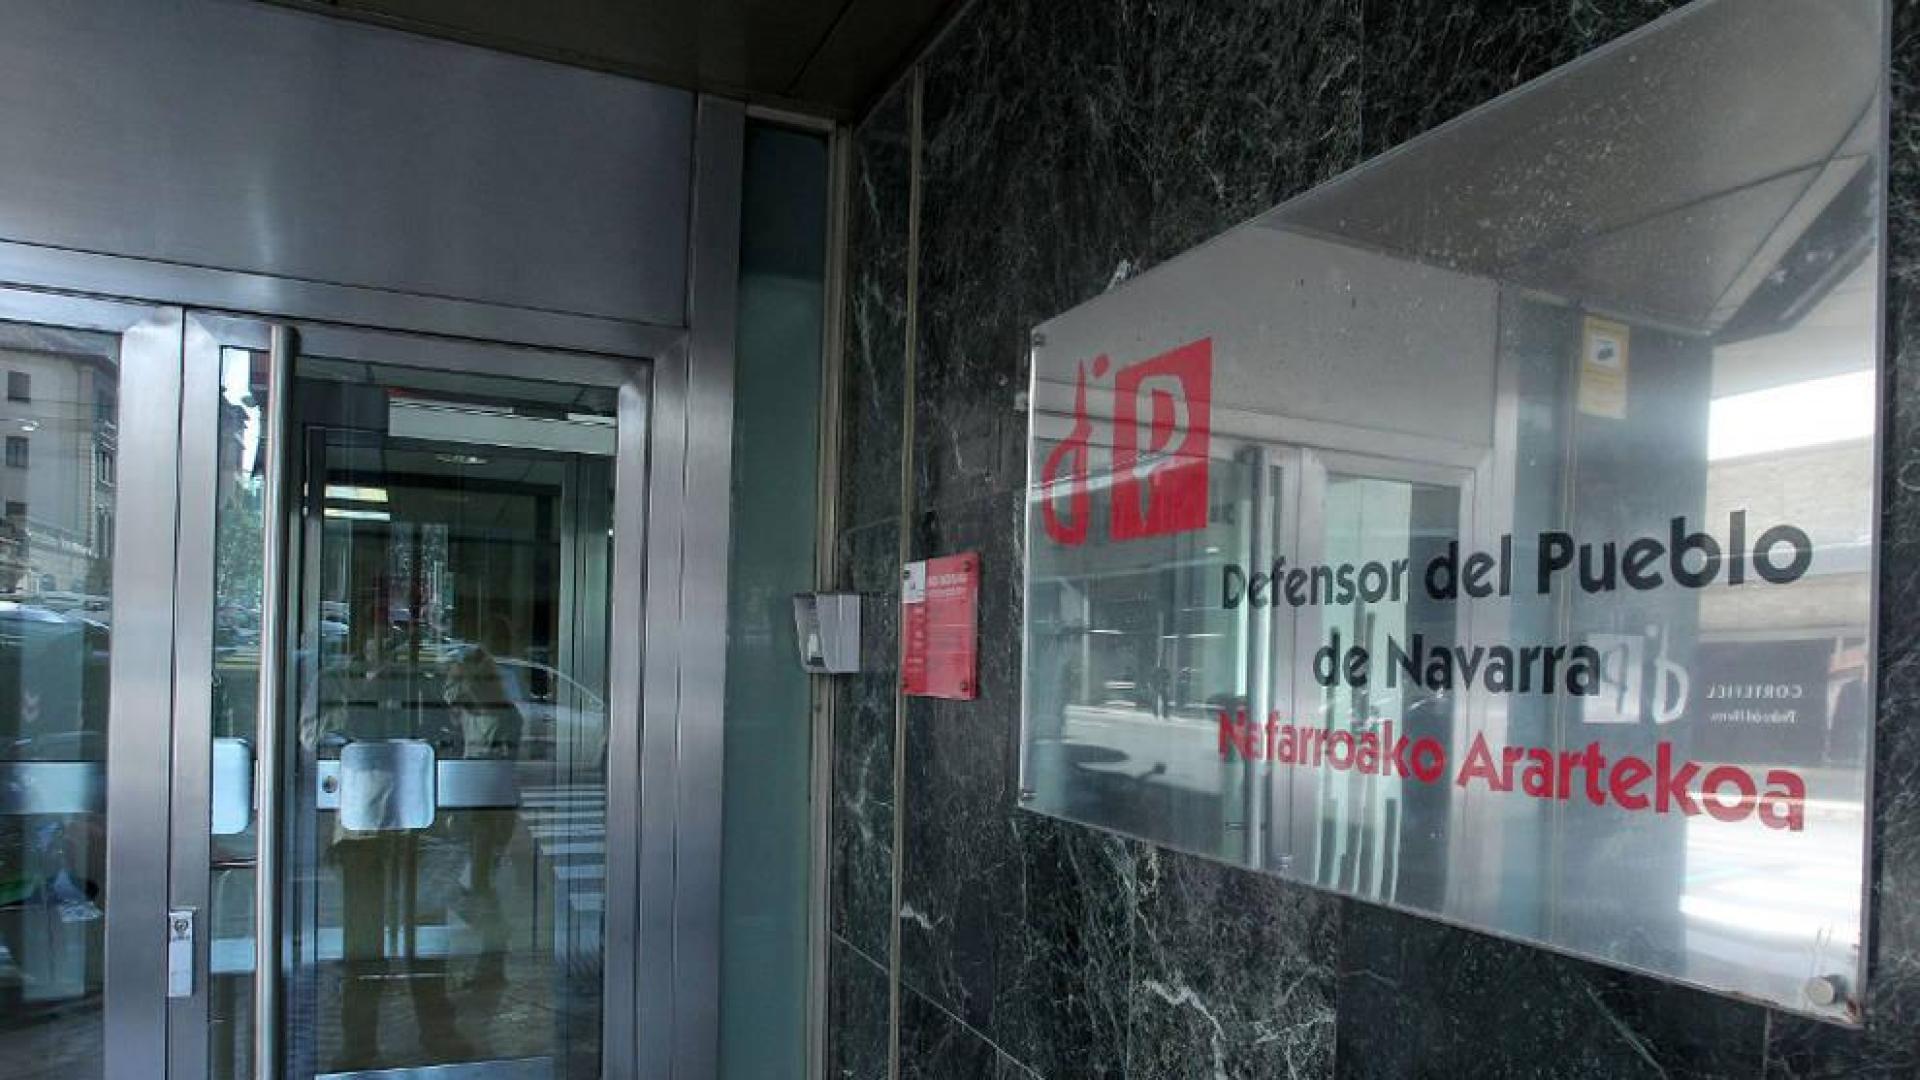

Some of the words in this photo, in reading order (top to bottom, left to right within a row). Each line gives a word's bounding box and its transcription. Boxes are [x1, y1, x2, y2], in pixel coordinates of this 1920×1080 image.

[1223, 555, 1410, 610] Defensor
[1425, 533, 1512, 601] del
[1537, 509, 1813, 594] Pueblo
[1313, 628, 1370, 688] de
[1386, 633, 1600, 697] Navarra
[1218, 707, 1447, 785] Nafarroako
[1456, 729, 1807, 832] Arartekoa
